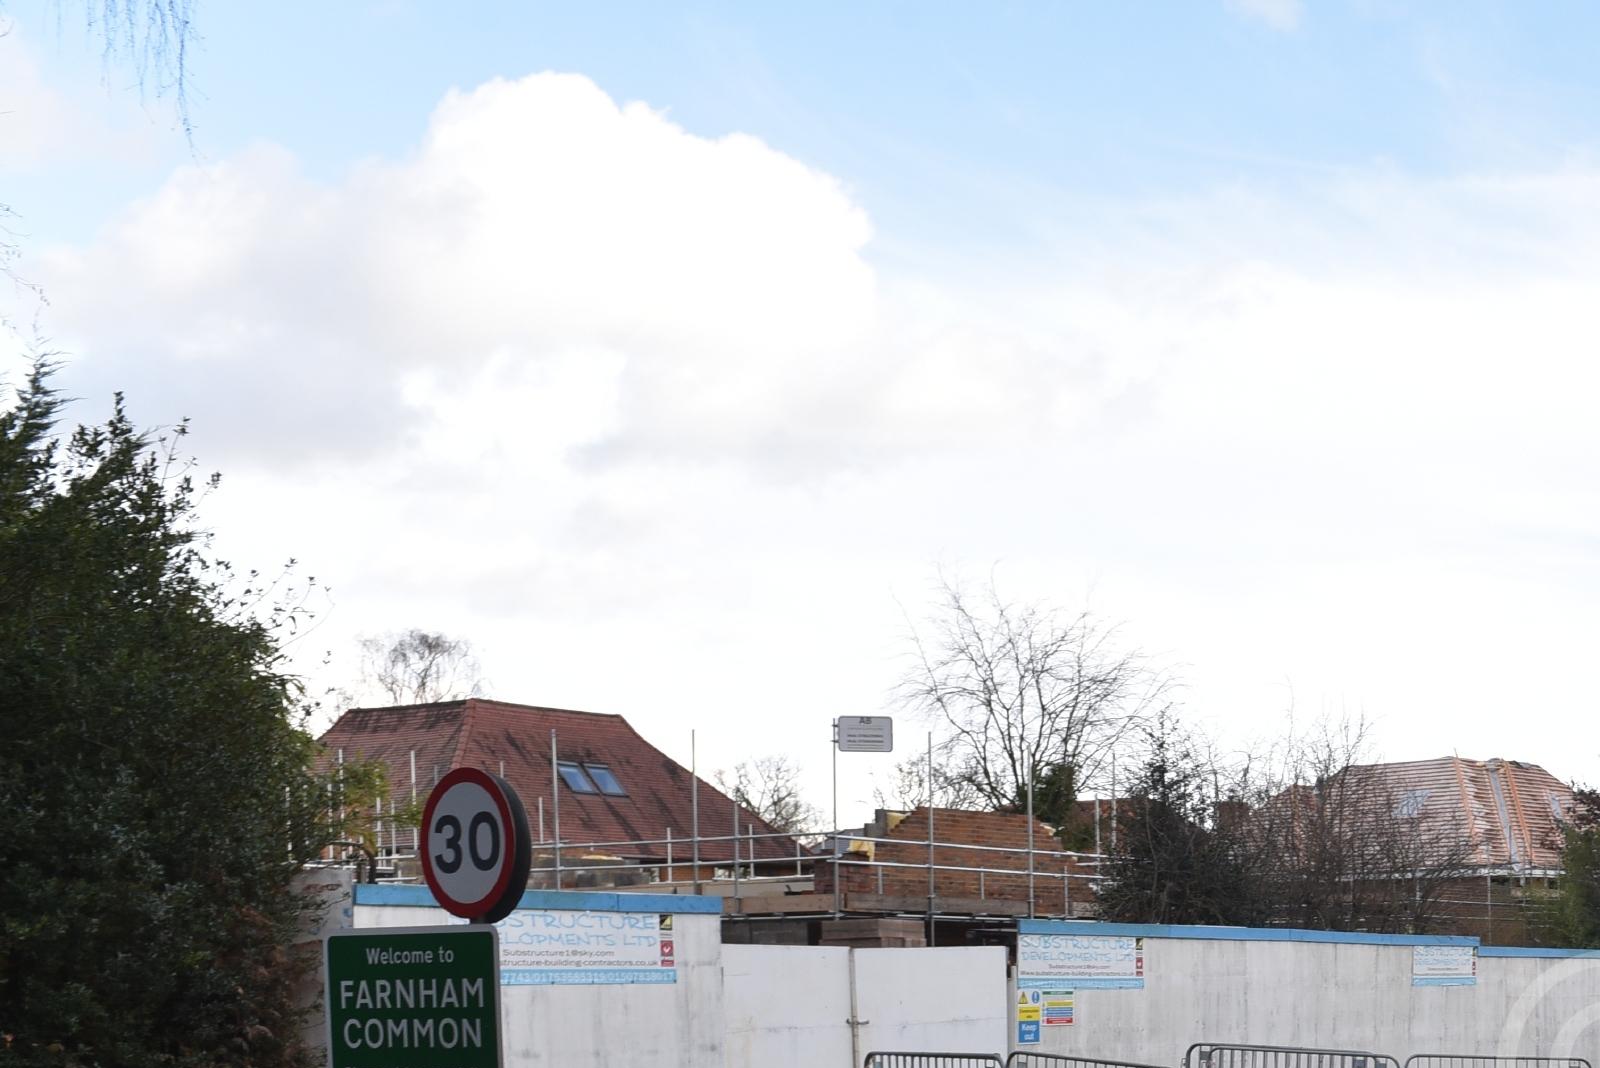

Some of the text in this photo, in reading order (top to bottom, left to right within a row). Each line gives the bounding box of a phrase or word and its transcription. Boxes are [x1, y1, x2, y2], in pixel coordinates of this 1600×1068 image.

[433, 811, 500, 874] 30
[499, 911, 657, 930] STRUCTURE
[623, 933, 658, 947] LTD
[366, 946, 455, 965] Welcome to
[340, 977, 485, 1009] FARNHAM
[343, 1017, 483, 1049] COMMON
